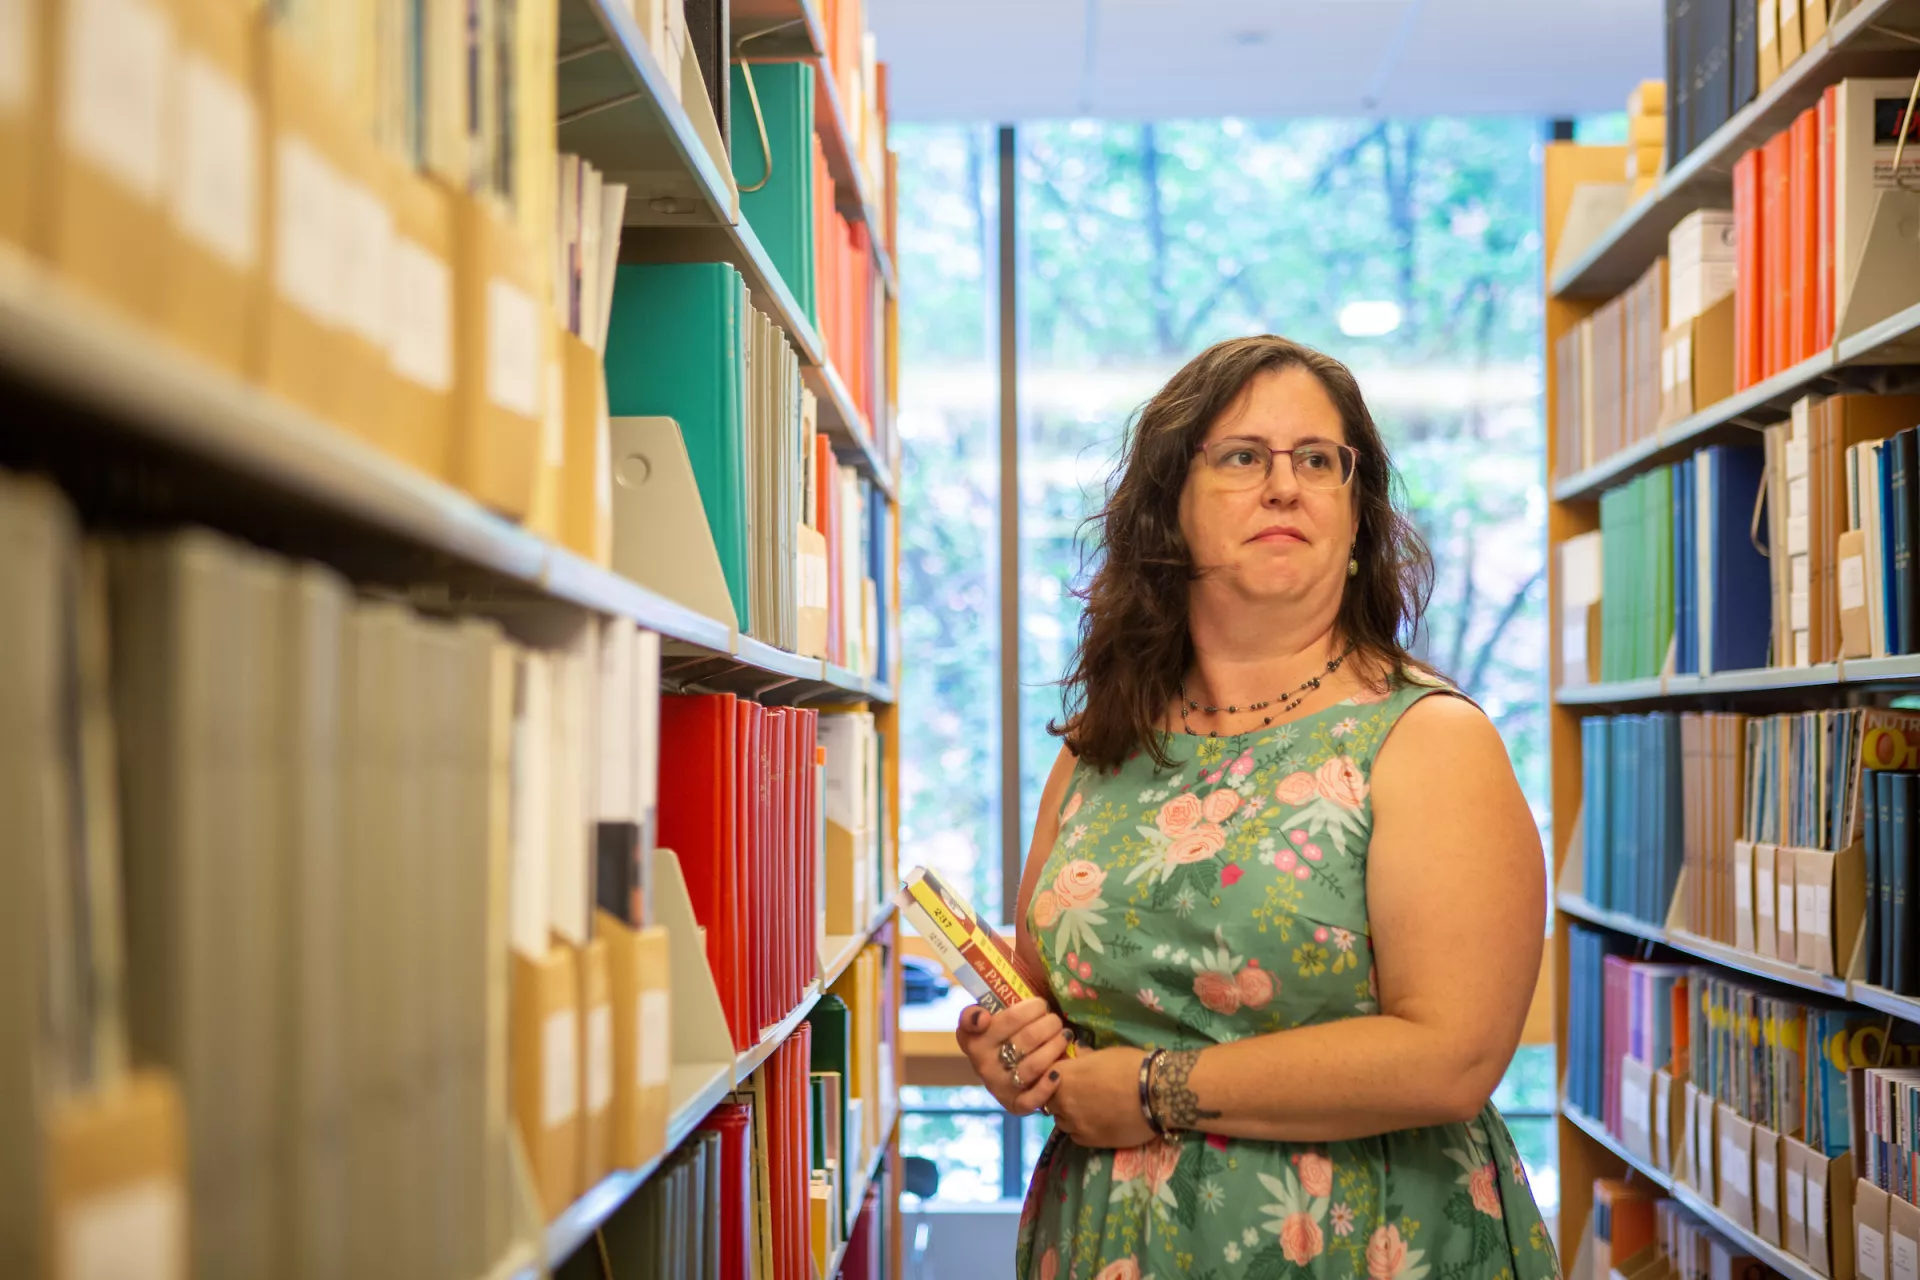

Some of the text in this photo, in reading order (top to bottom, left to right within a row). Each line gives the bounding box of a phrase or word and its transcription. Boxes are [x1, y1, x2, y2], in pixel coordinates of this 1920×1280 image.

[974, 960, 986, 971] the
[984, 968, 1020, 1007] PARIS
[980, 993, 1003, 1016] PA
